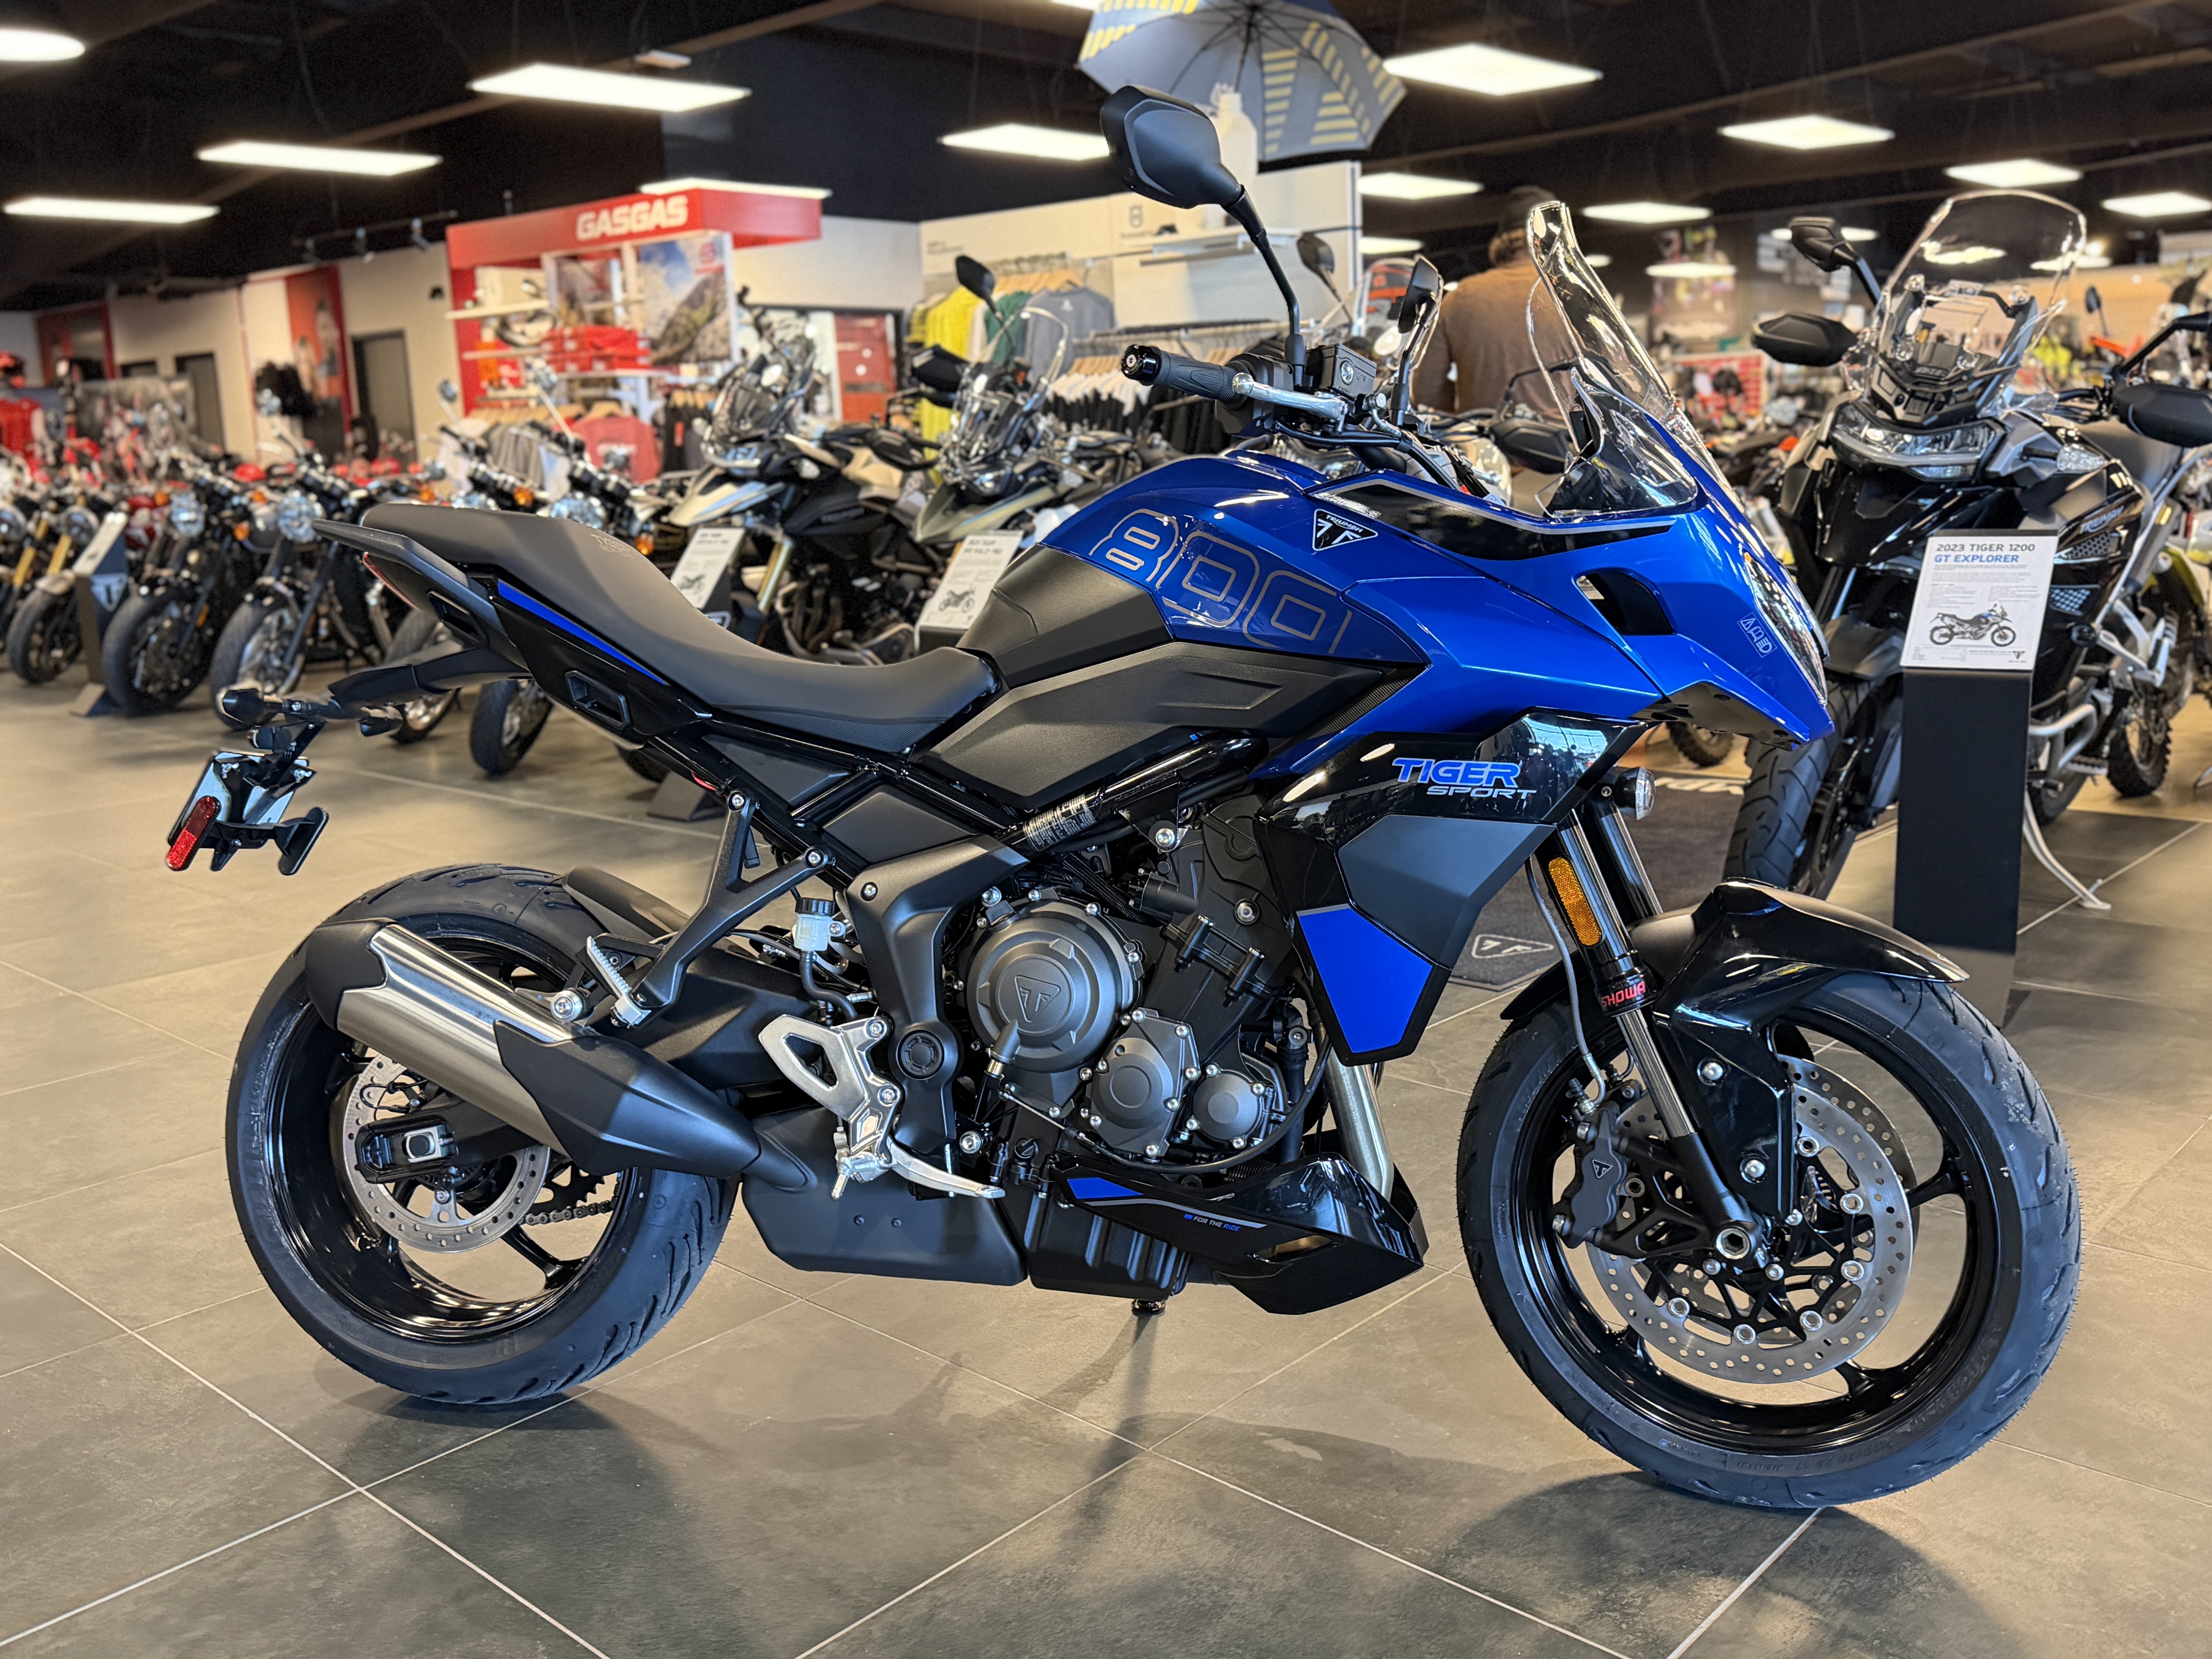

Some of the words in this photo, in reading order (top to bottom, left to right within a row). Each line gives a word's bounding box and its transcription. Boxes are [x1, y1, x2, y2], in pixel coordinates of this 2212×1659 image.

[576, 196, 688, 240] GASGAS
[1326, 514, 1364, 533] TRIUMPH
[1936, 543, 1965, 552] 2023
[1970, 543, 2004, 552] TIGER
[2009, 543, 2035, 552] 1200
[1934, 554, 1950, 563] GT
[1953, 554, 2019, 563] EXPLORER
[1089, 508, 1352, 655] 800
[1392, 757, 1522, 788] TIGER
[1426, 785, 1537, 800] SPORT
[1601, 981, 1646, 1008] SHOWA
[1193, 1216, 1208, 1224] FOR
[1209, 1219, 1223, 1228] THE
[1223, 1223, 1241, 1232] RIDE
